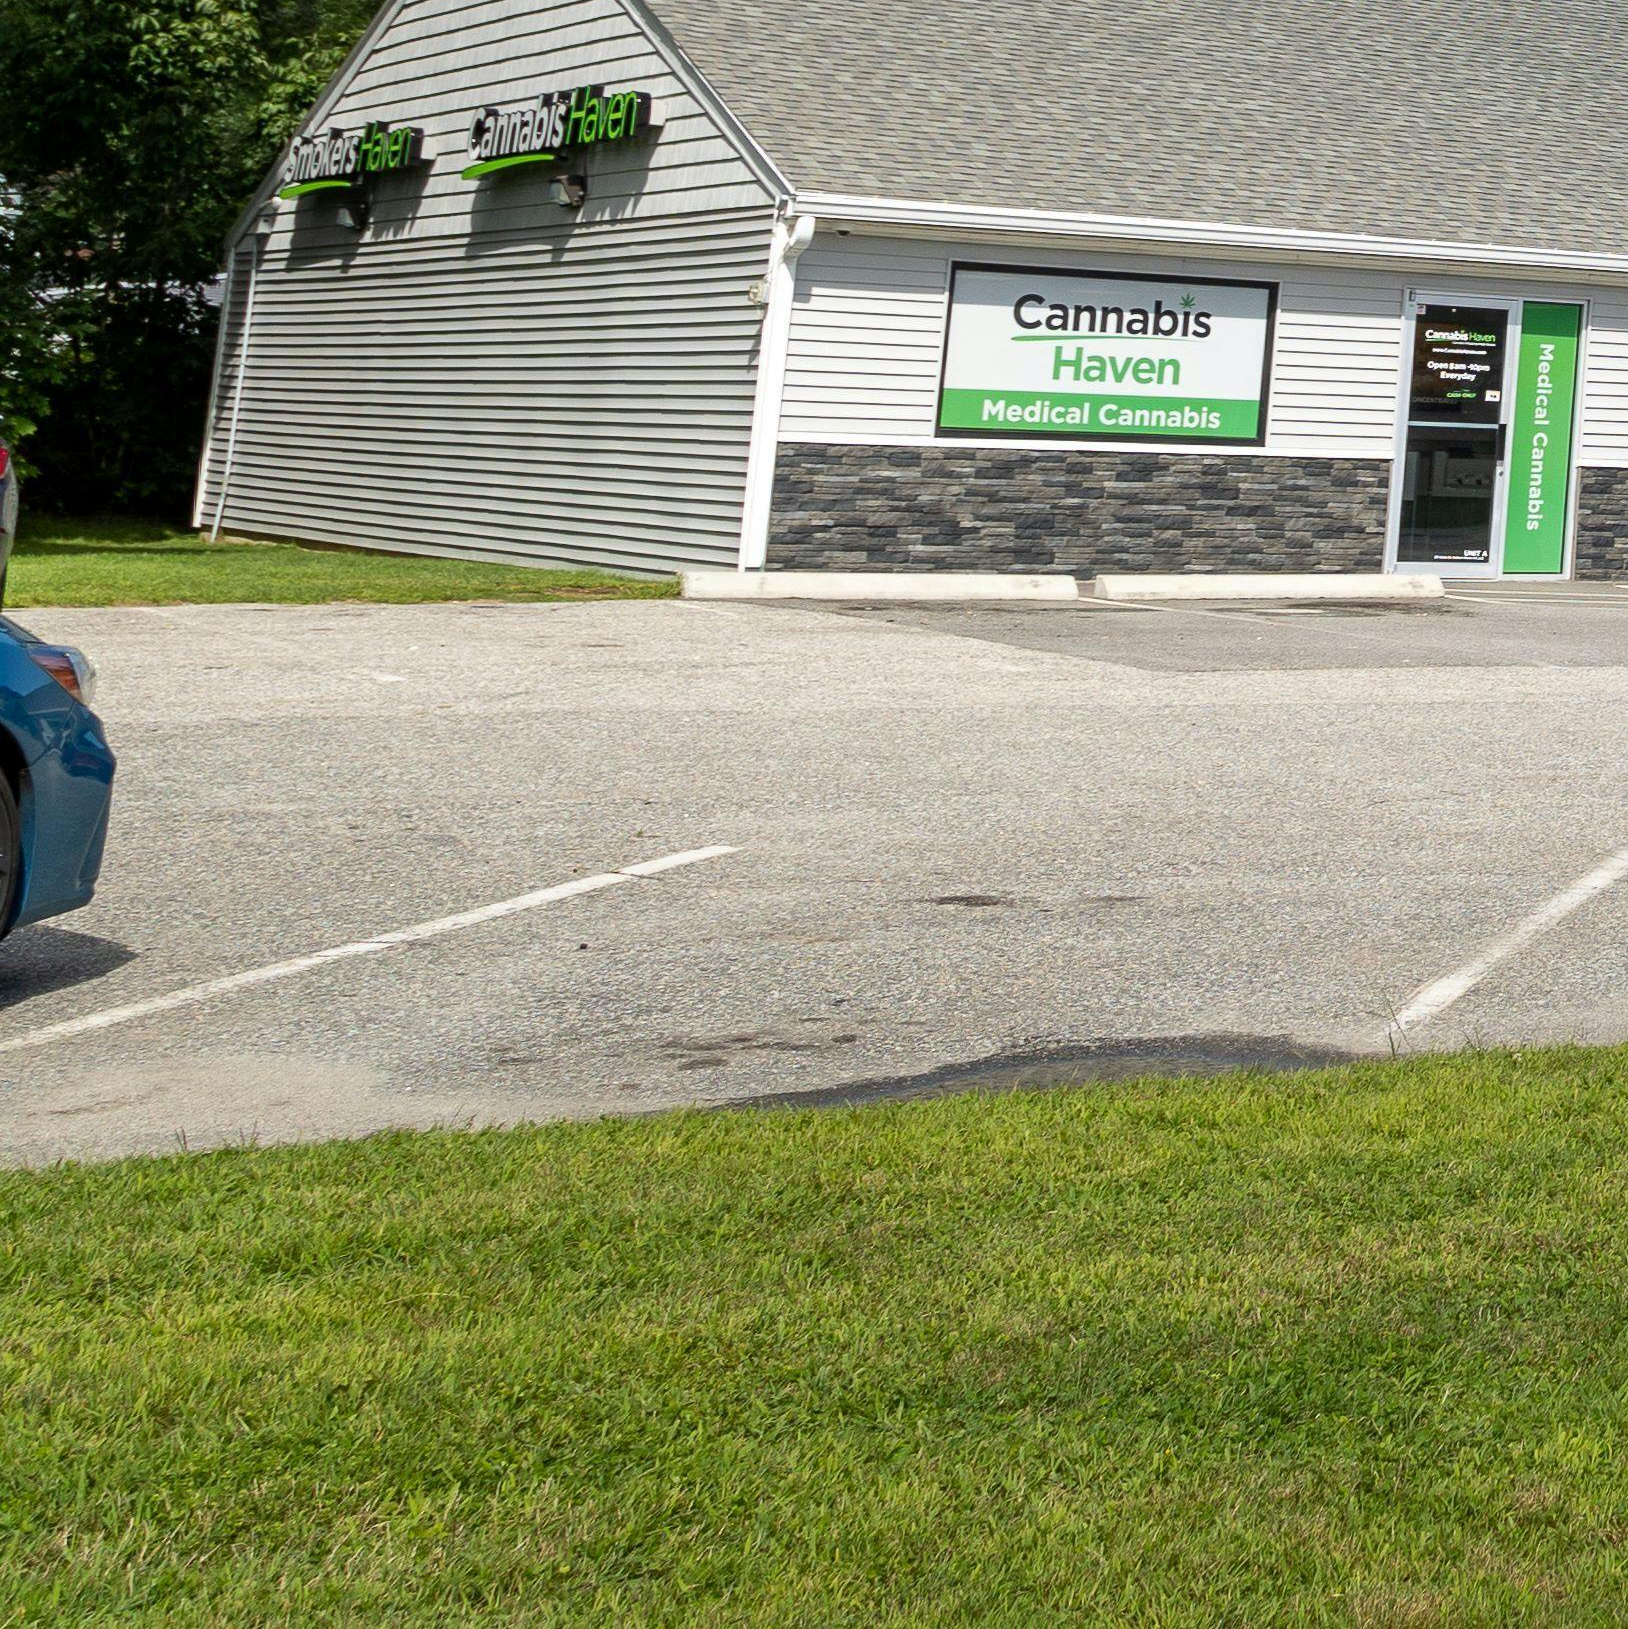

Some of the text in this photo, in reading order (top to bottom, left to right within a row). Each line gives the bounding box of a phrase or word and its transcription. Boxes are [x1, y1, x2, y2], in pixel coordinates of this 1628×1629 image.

[468, 86, 639, 160] Cannabis Haven
[284, 122, 412, 183] Smokers Haven
[1013, 293, 1213, 339] Cannabis
[1425, 329, 1496, 342] Cannabis Haven
[1052, 346, 1181, 385] Haven
[981, 399, 1221, 429] Medical Cannabis
[1526, 343, 1555, 531] Medical Cannabis
